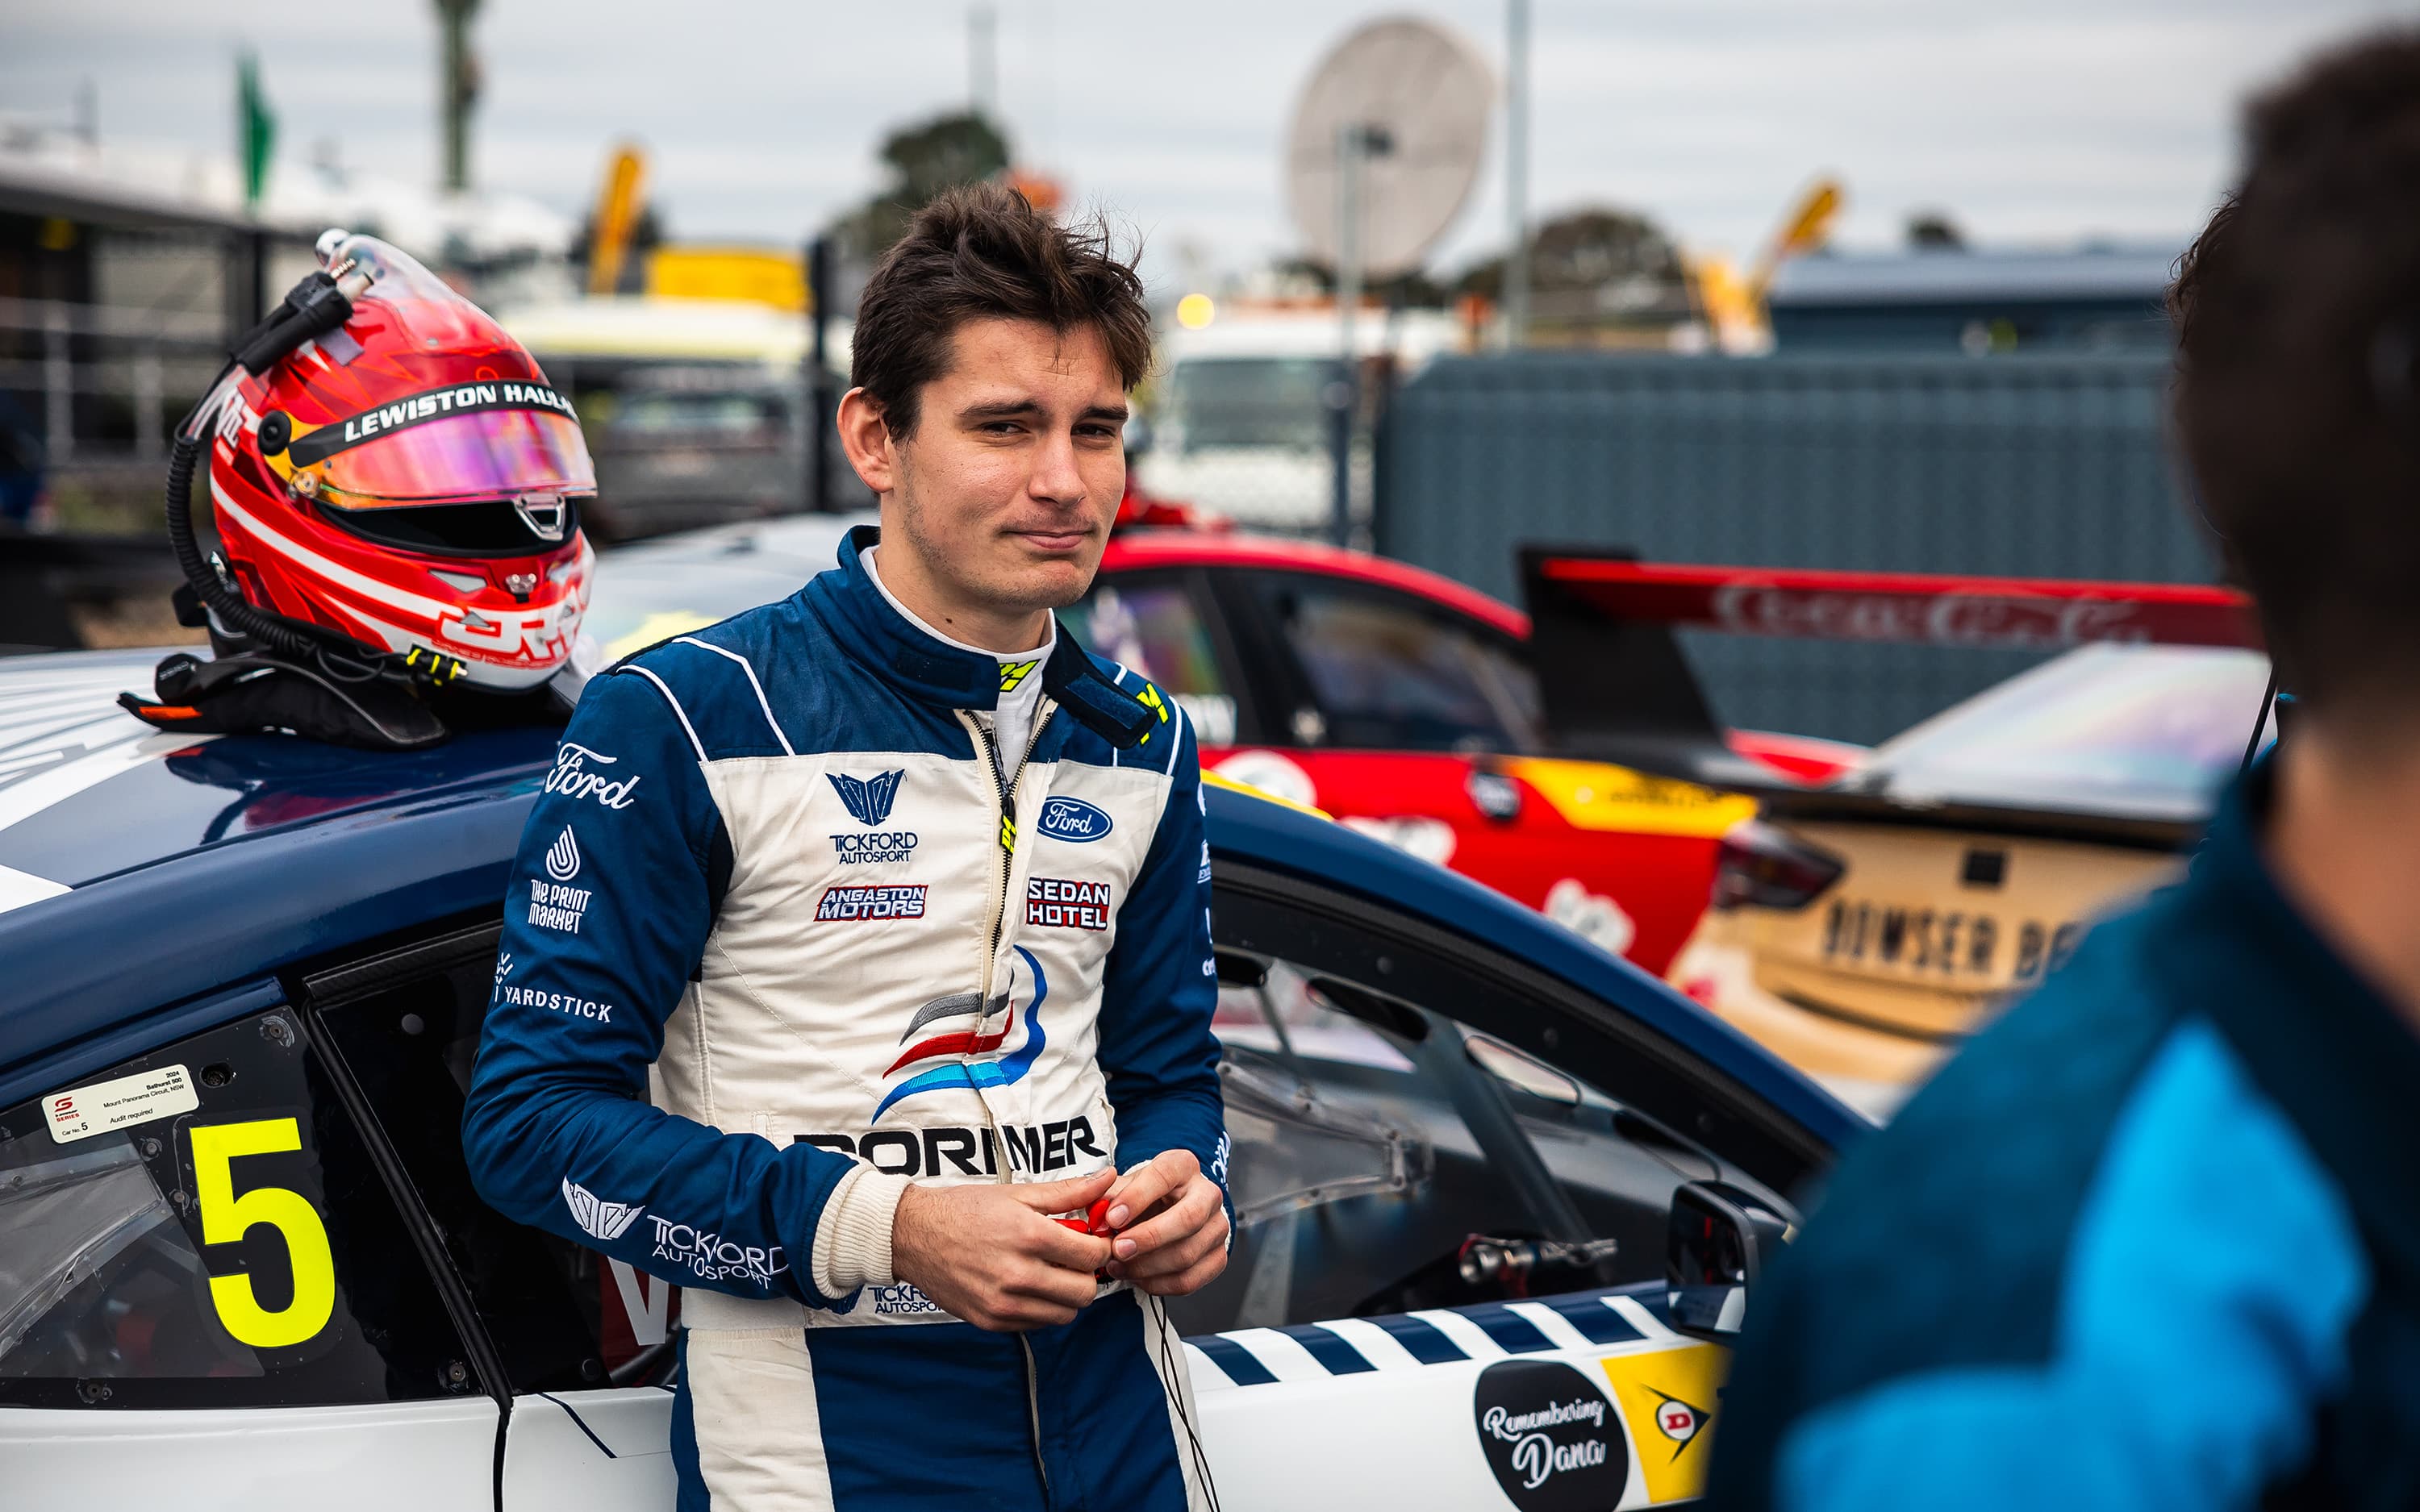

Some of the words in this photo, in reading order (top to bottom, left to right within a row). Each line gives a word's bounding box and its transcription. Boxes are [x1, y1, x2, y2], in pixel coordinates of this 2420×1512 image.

[344, 384, 498, 443] LEWISTON
[546, 741, 641, 810] Ford
[1045, 802, 1093, 834] Ford
[828, 831, 919, 852] TICKFORD
[839, 849, 912, 865] AUTOSPORT
[549, 884, 593, 912] PRINT
[824, 886, 926, 903] ANGASTON
[1028, 879, 1109, 906] SEDAN
[817, 899, 924, 919] MOTORS
[1028, 903, 1108, 928] HOTEL
[504, 985, 613, 1023] YARDSTICK
[146, 1080, 171, 1091] Bathurst
[171, 1077, 182, 1085] 500
[165, 1069, 180, 1079] 2024
[102, 1100, 122, 1109] Mount
[122, 1093, 151, 1105] Panorama
[170, 1082, 186, 1092] NSW
[56, 1112, 80, 1123] SERIES
[110, 1114, 127, 1124] Audit
[127, 1107, 154, 1119] required
[61, 1129, 72, 1137] Car
[71, 1127, 81, 1135] No.
[81, 1121, 89, 1131] 5
[190, 1117, 336, 1347] 5
[652, 1244, 772, 1290] AUTOSPORT
[875, 1301, 941, 1314] AUTOSPO
[1483, 1398, 1606, 1442] Remembering
[1667, 1412, 1692, 1431] D
[1512, 1432, 1607, 1489] Dana
